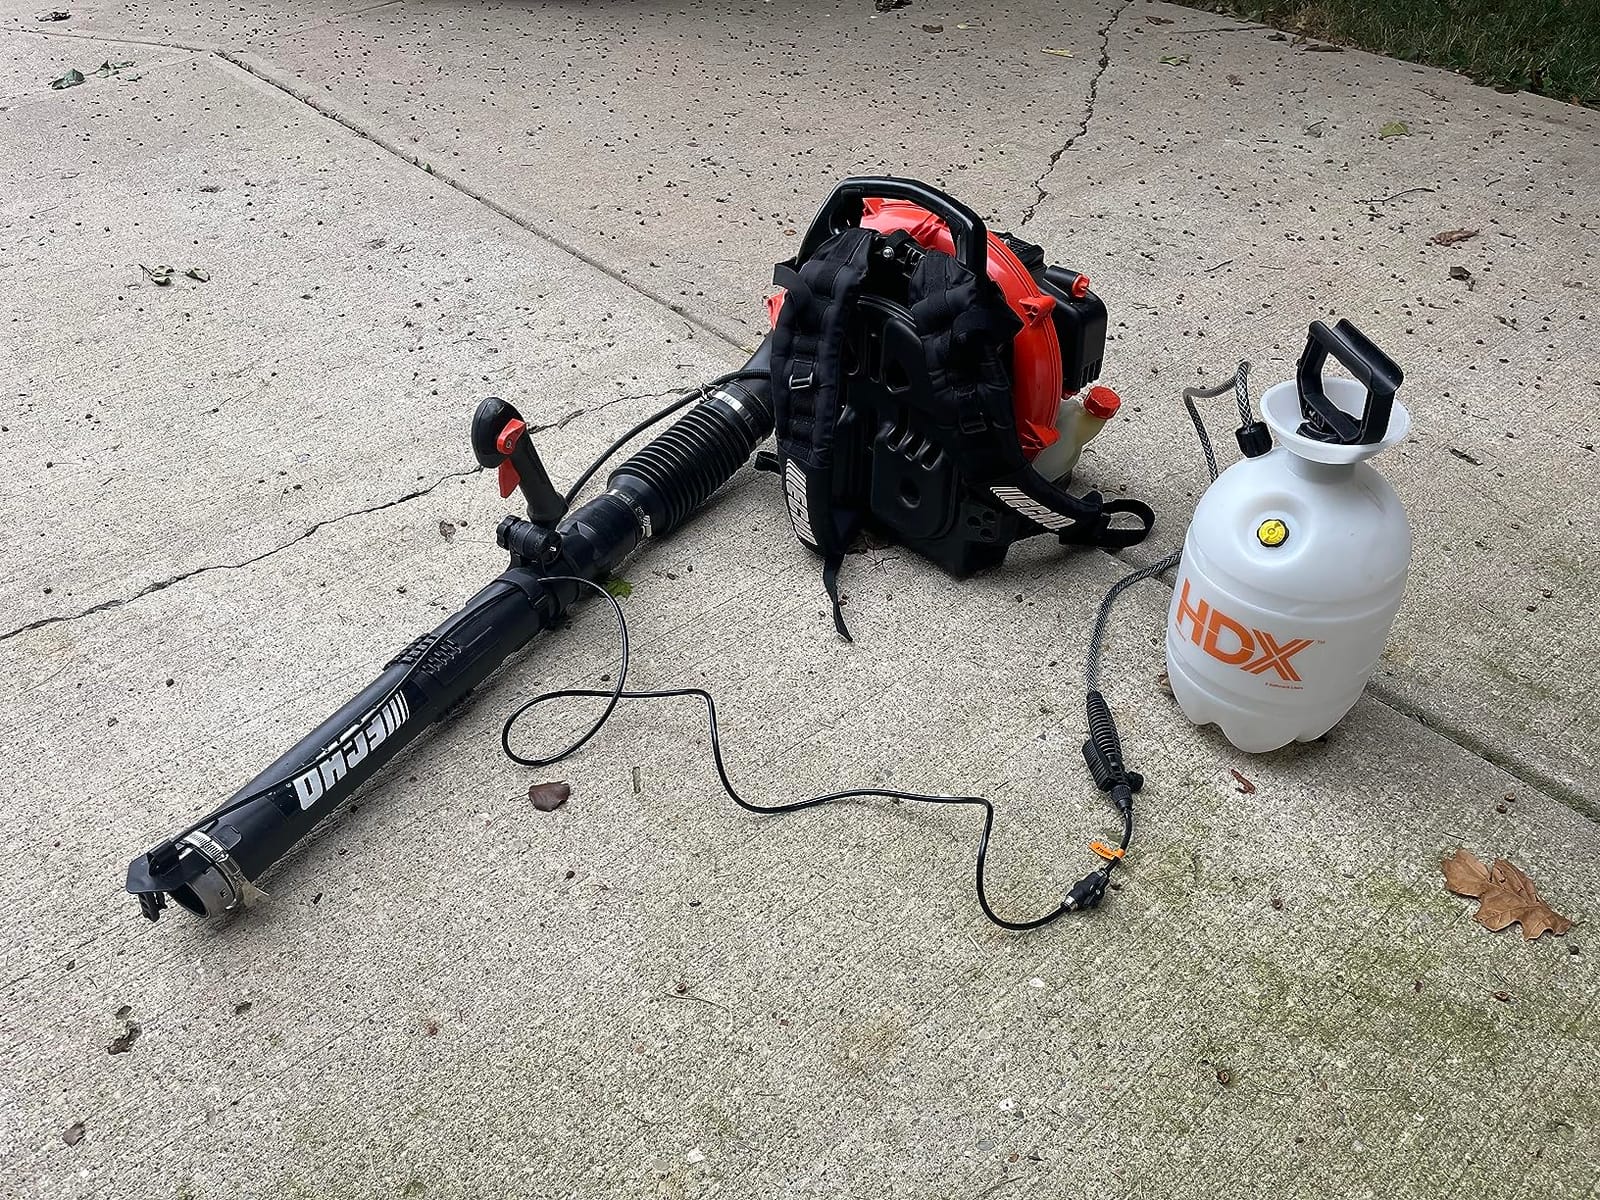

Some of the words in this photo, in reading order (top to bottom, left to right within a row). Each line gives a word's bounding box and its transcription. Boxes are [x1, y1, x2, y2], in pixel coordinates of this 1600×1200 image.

[1004, 498, 1077, 530] ECHO
[1176, 577, 1315, 682] HDX
[292, 708, 388, 811] ECHO
